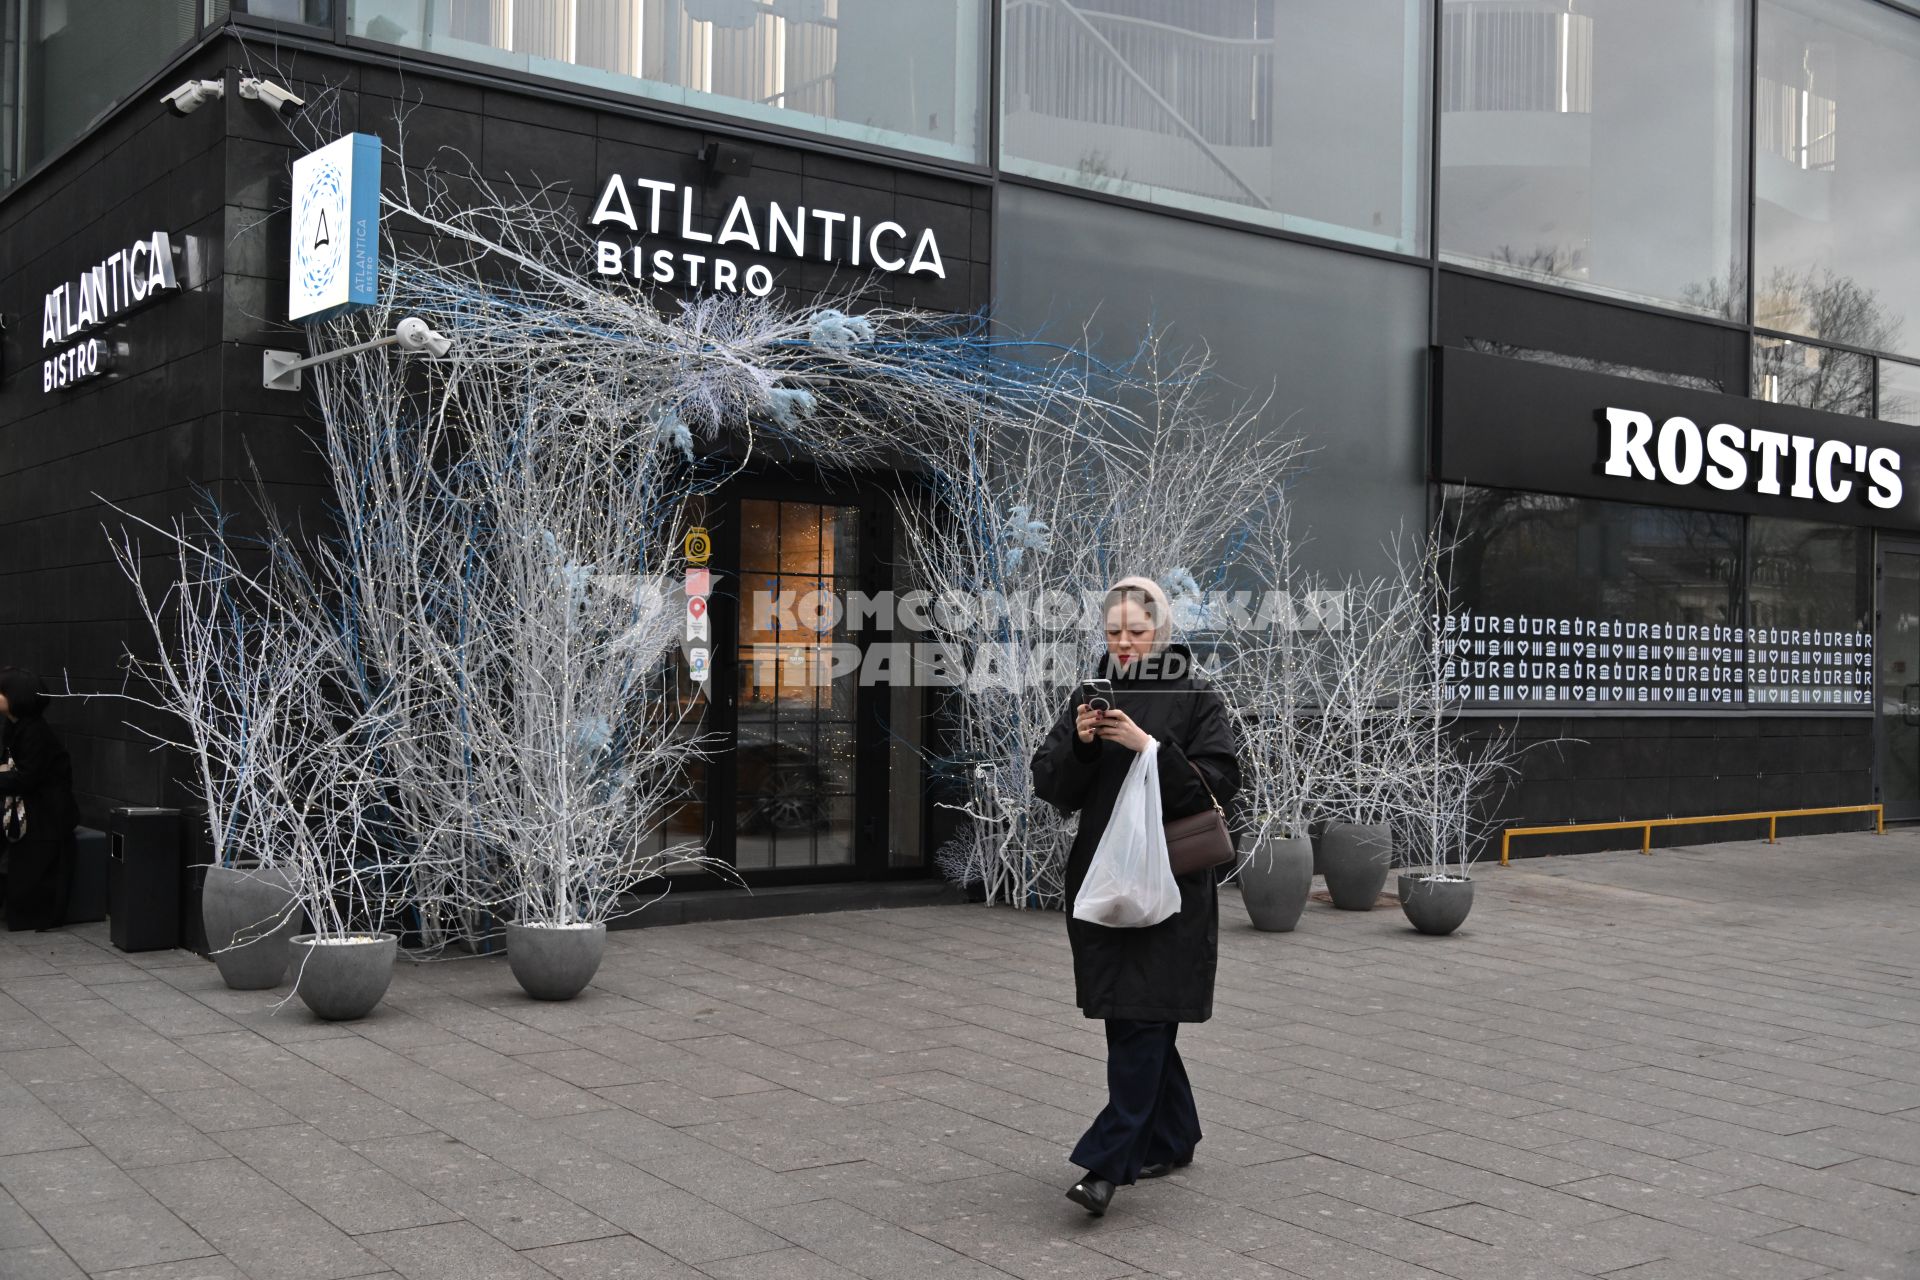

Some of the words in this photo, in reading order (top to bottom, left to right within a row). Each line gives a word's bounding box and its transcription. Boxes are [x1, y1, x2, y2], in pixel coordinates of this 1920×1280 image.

[355, 220, 367, 294] ATLANTICA
[591, 173, 946, 279] ATLANTICA
[42, 231, 168, 348] ATLANTICA
[597, 240, 774, 297] BISTRO
[43, 338, 98, 393] BISTRO
[1604, 406, 1905, 510] ROSTIC'S
[1490, 616, 1500, 633] R
[1547, 618, 1556, 635] R
[1587, 620, 1596, 637] R
[1639, 622, 1648, 639] R
[1689, 624, 1698, 641] R
[1723, 627, 1732, 643] R
[1748, 628, 1756, 644] R
[1792, 630, 1800, 646] R
[1834, 632, 1842, 647] R
[1864, 633, 1872, 648] R
[1490, 661, 1500, 678] R
[1546, 662, 1556, 679] R
[1586, 663, 1596, 680] R
[1639, 664, 1648, 681] R
[1688, 665, 1697, 682] R
[1722, 667, 1732, 683] R
[1747, 667, 1756, 684] R
[1792, 668, 1800, 684] R
[1834, 669, 1842, 685] R
[1864, 671, 1872, 685] R
